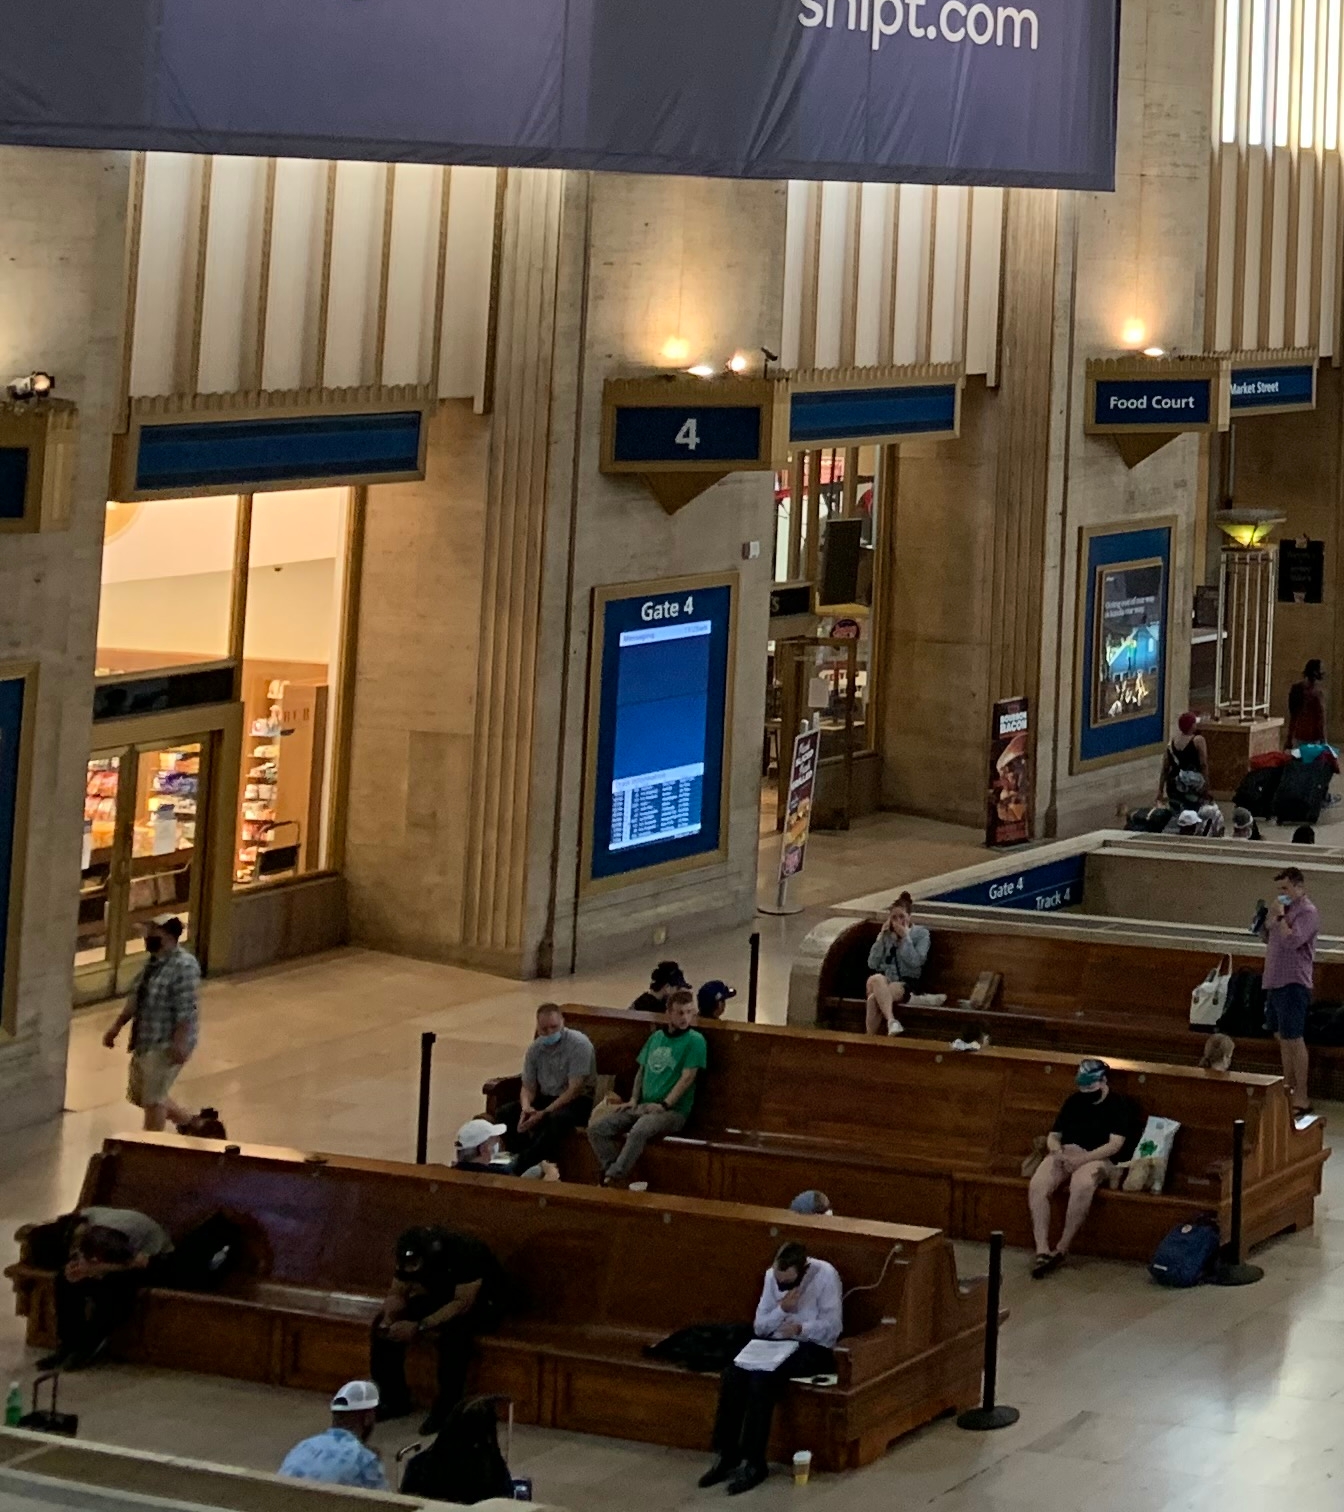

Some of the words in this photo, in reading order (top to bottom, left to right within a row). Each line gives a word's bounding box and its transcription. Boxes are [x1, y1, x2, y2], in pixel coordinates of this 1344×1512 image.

[1257, 381, 1279, 394] Street
[1110, 396, 1147, 410] Food
[1152, 396, 1195, 409] Court
[675, 417, 700, 451] 4
[641, 600, 680, 622] Gate
[683, 596, 694, 615] 4
[989, 882, 1014, 900] Gate
[1016, 876, 1024, 891] 4
[1036, 890, 1061, 911] Track
[1063, 887, 1071, 901] 4
